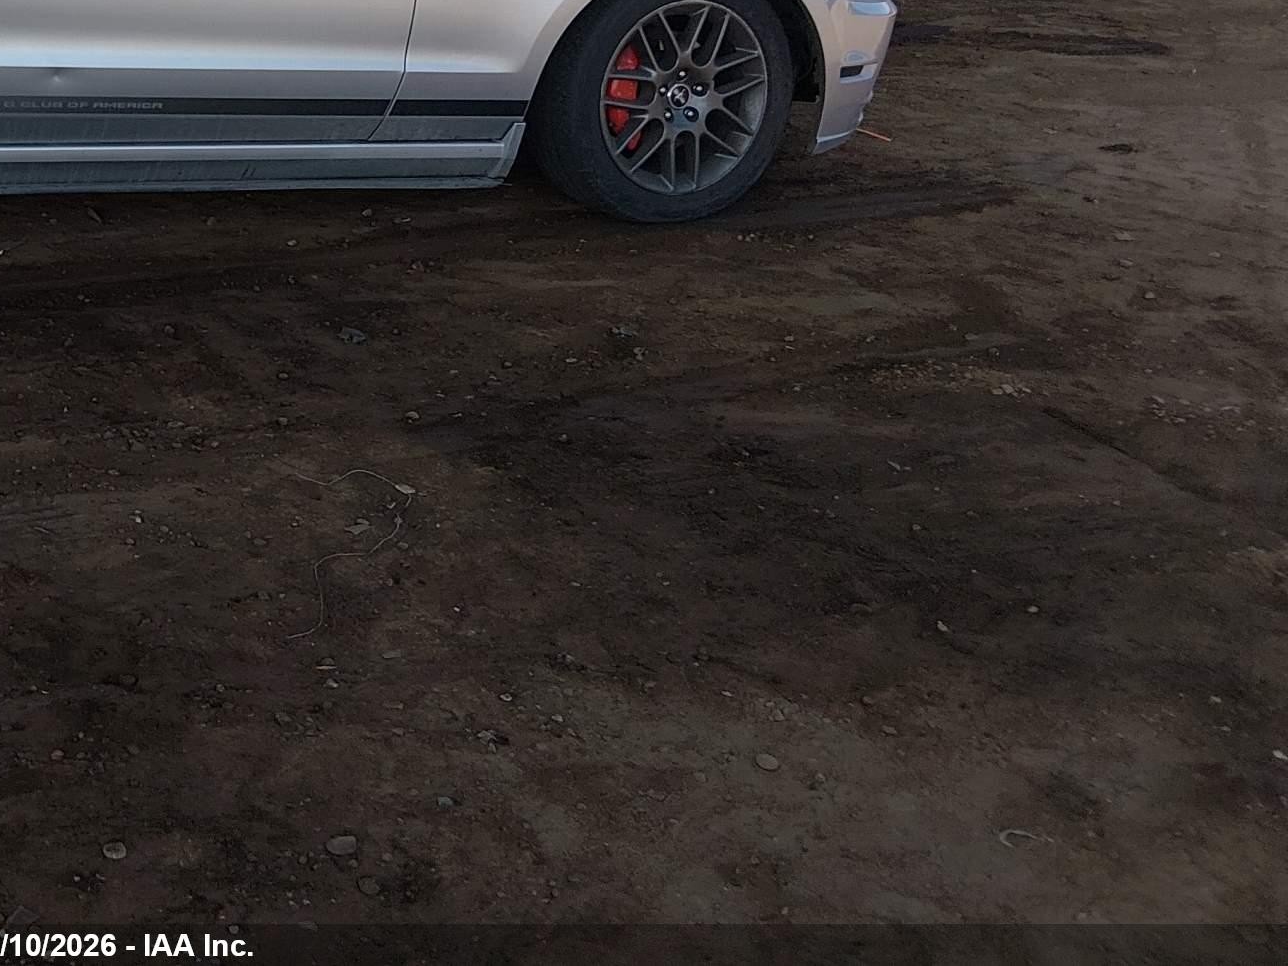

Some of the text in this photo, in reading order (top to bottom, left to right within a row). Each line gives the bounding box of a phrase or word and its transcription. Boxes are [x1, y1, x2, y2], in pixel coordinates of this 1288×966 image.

[20, 100, 64, 109] CLUB
[67, 101, 90, 109] OF
[93, 101, 164, 110] AMERICA
